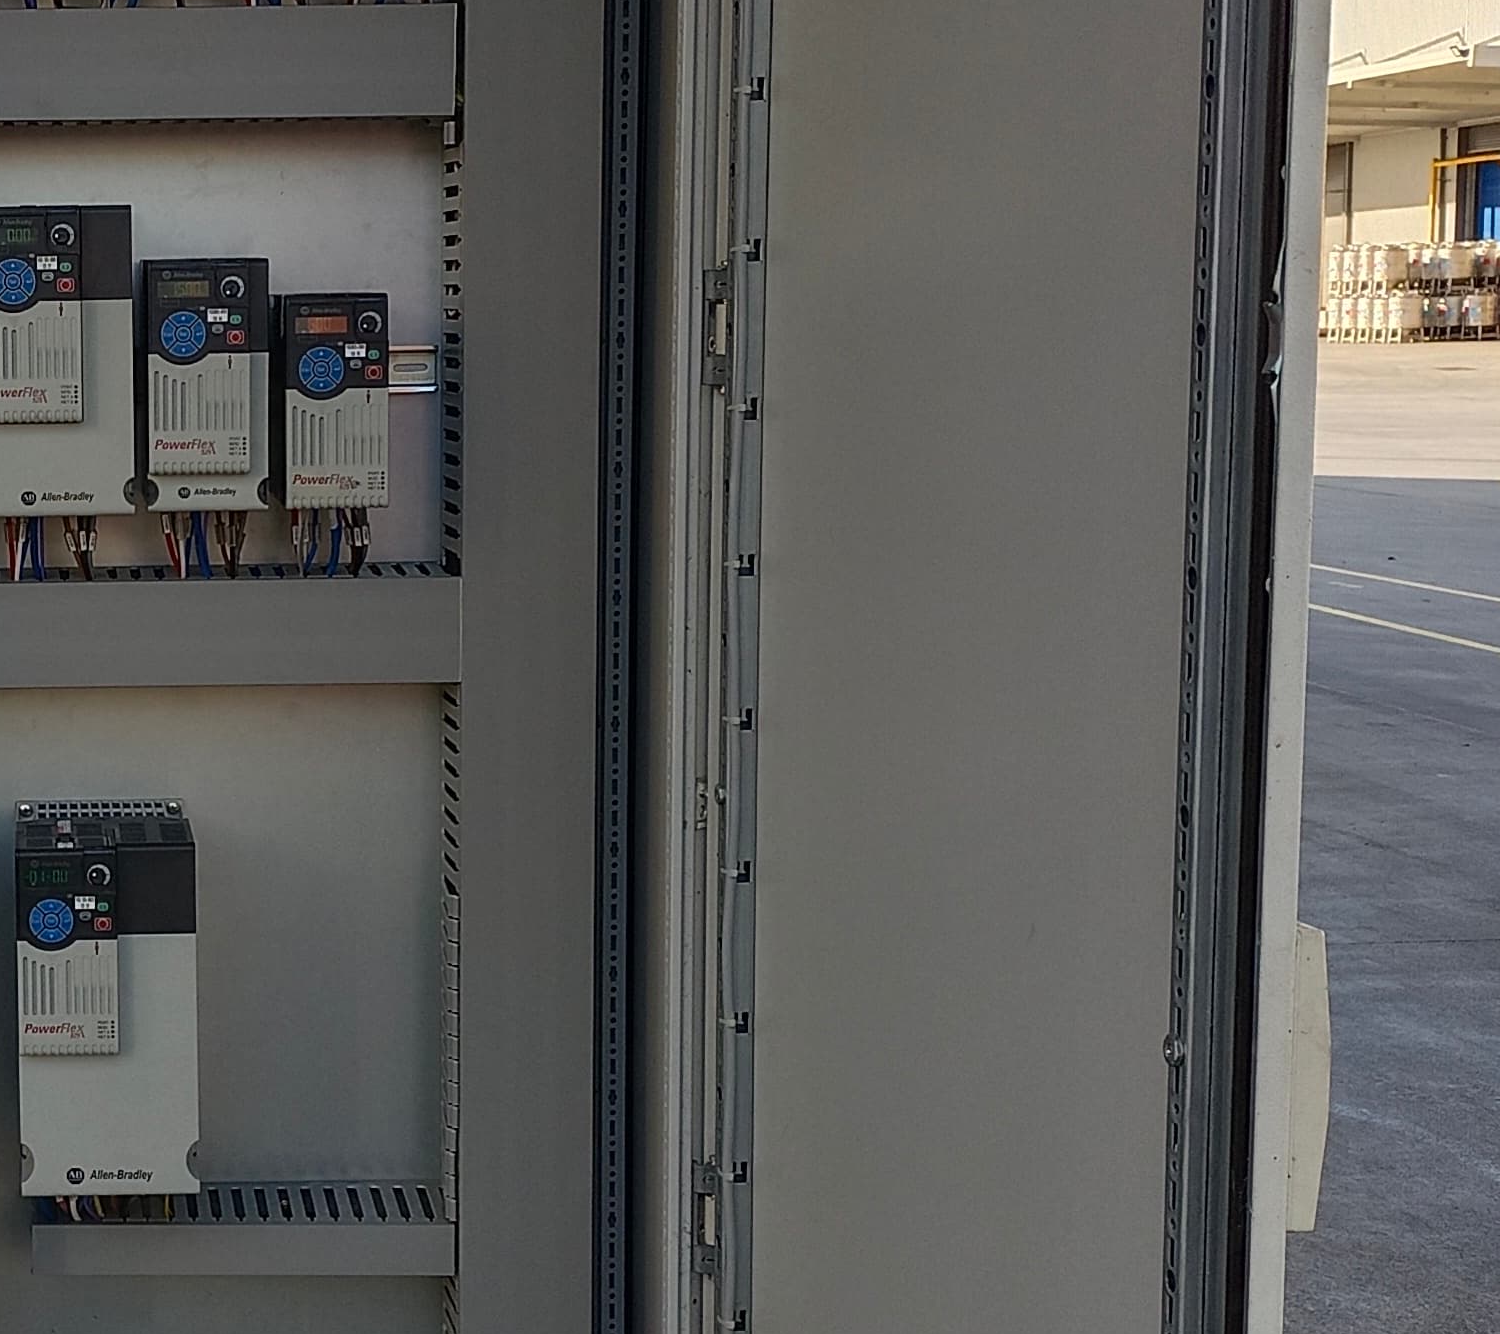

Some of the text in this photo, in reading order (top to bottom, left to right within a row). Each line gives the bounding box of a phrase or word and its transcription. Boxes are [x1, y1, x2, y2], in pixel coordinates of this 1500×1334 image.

[155, 438, 216, 455] PowerFlex
[293, 473, 355, 490] PowerFlex
[41, 491, 94, 503] Allen-Bradley
[194, 487, 237, 497] Allen-Bradley
[25, 1023, 85, 1039] PowerFlex
[90, 1170, 153, 1182] Allen-Bradley
